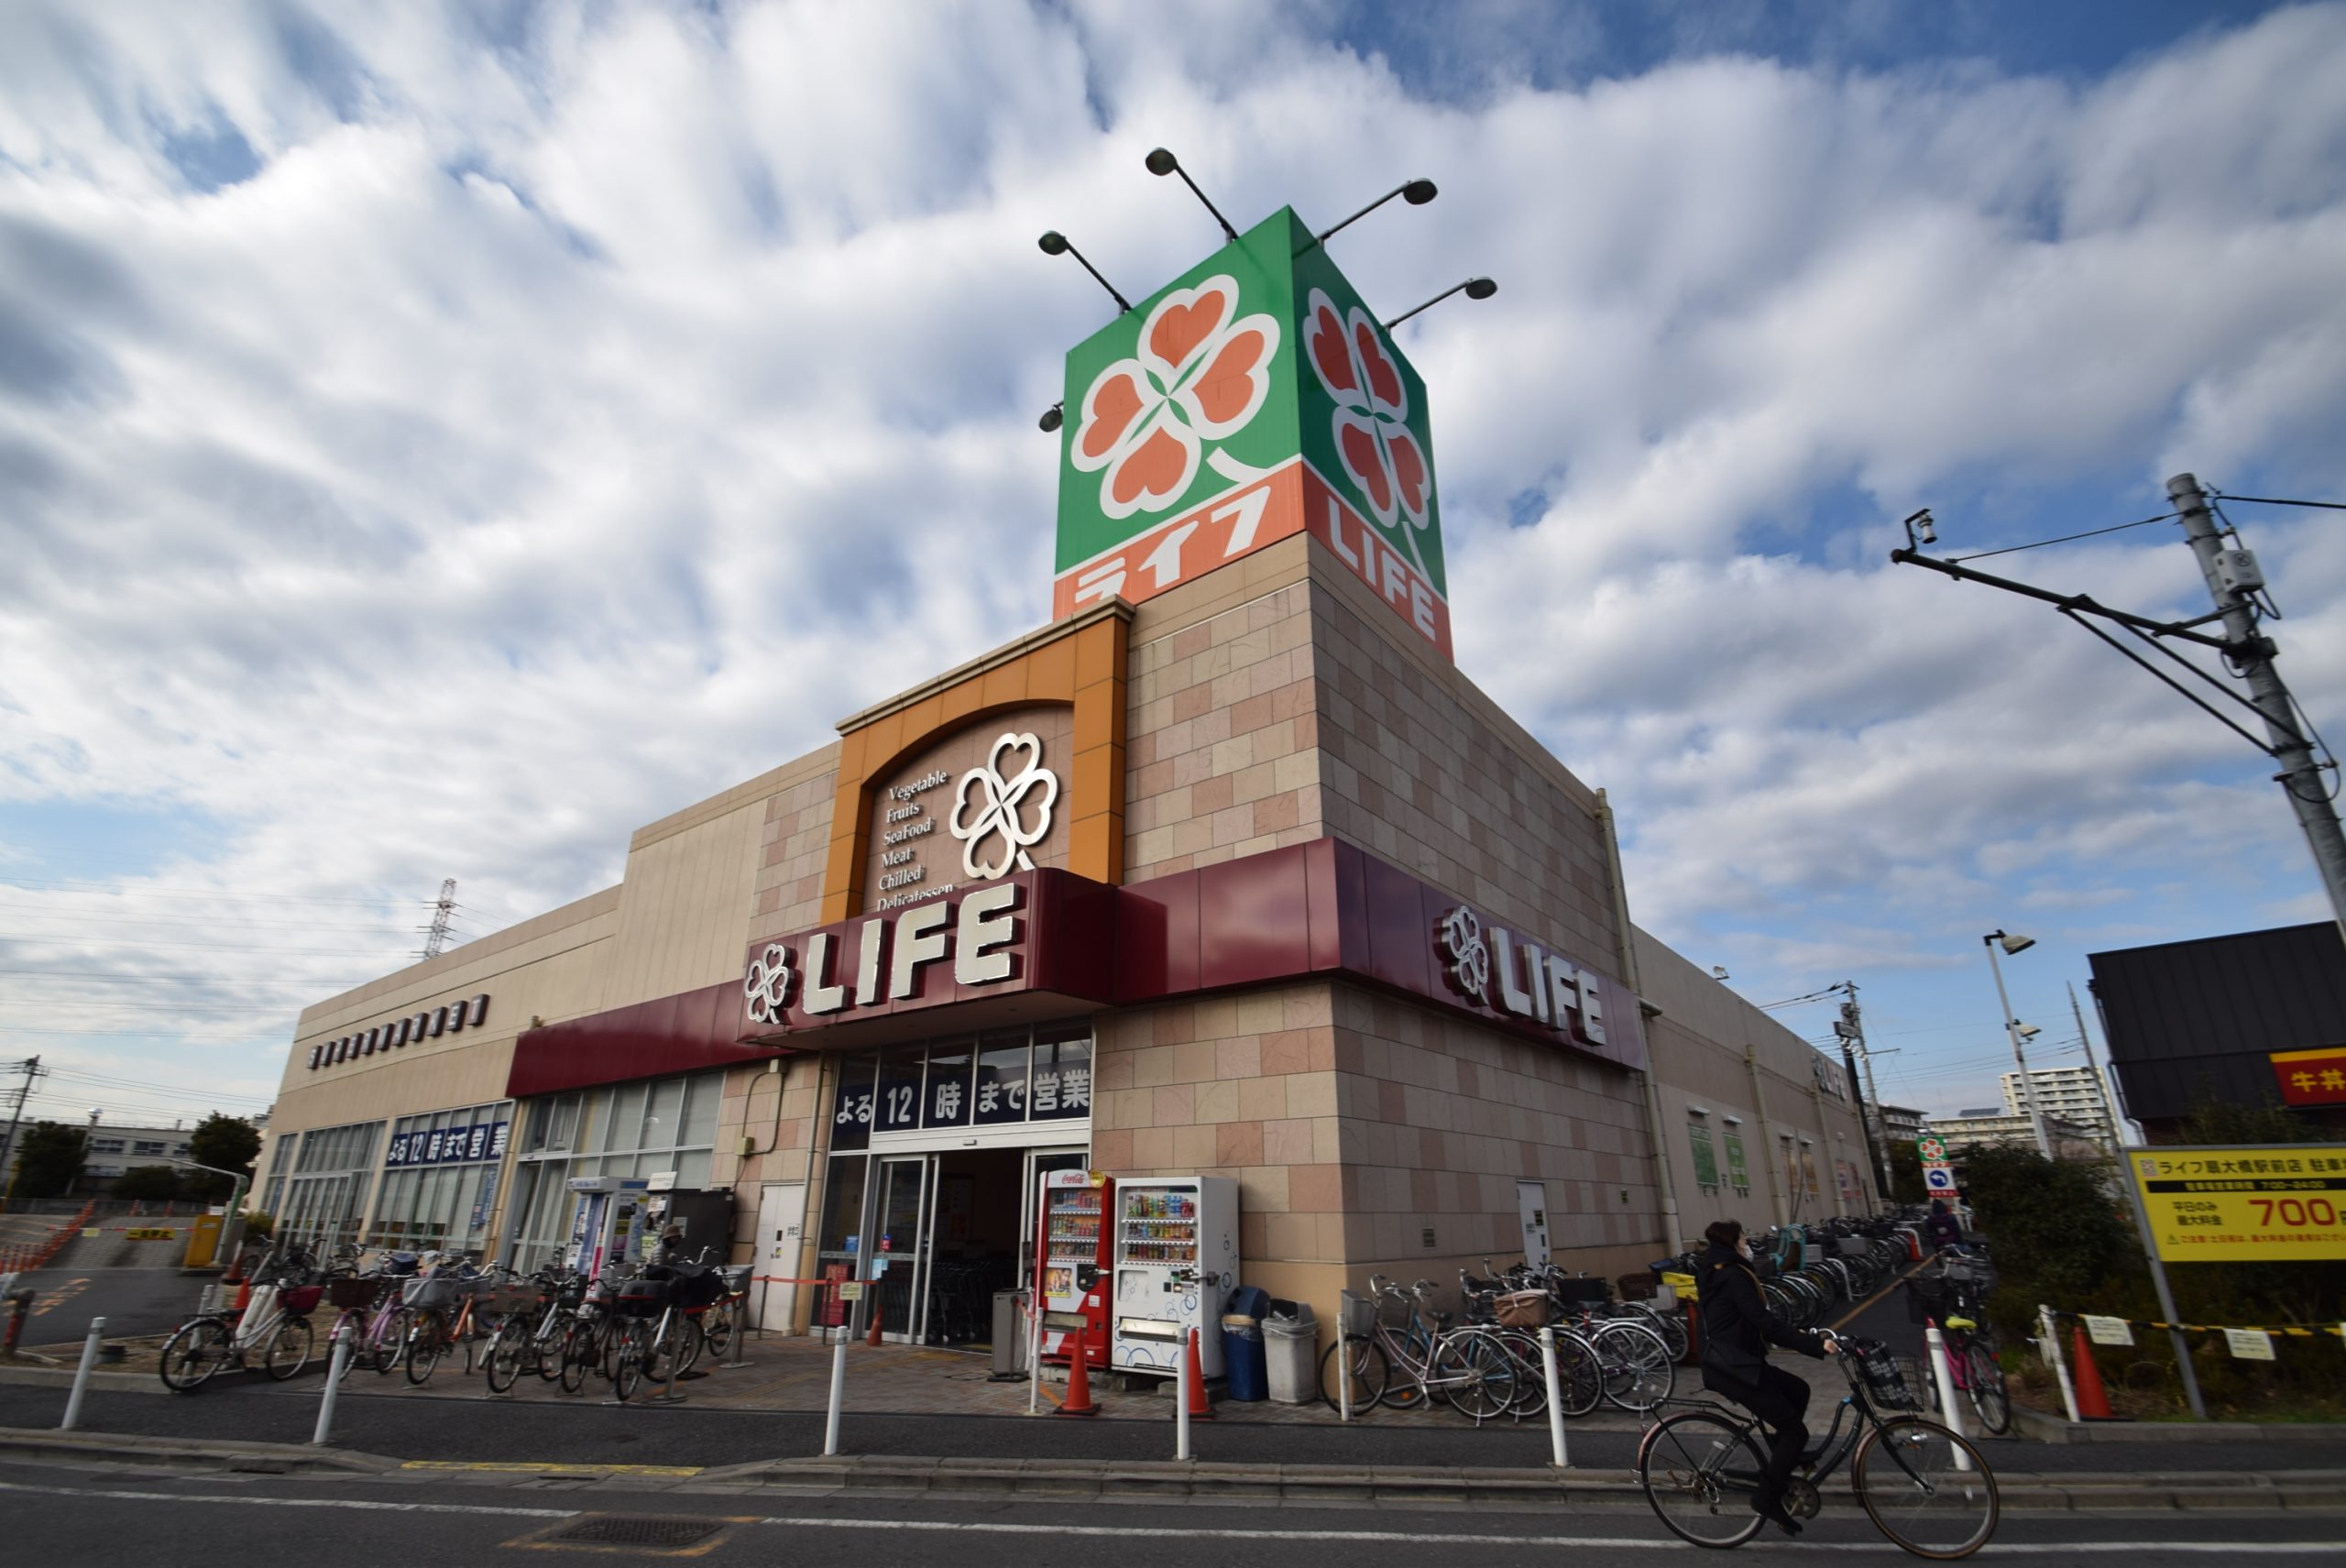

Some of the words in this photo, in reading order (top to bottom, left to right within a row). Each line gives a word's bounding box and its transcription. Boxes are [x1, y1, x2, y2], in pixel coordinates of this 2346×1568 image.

[1074, 486, 1271, 604] ライフ
[1328, 496, 1436, 643] LIFE
[889, 770, 948, 800] Vegetable
[886, 803, 920, 824] Fruits
[883, 817, 932, 846] SeaFood
[881, 847, 912, 868] Meat
[879, 865, 922, 891] Chilled
[803, 883, 1019, 1014] LIFE
[1488, 927, 1606, 1047] LIFE
[2291, 1069, 2346, 1092] 牛丼
[836, 1069, 1091, 1124] よる12時まで営業
[2247, 1198, 2336, 1226] 700
